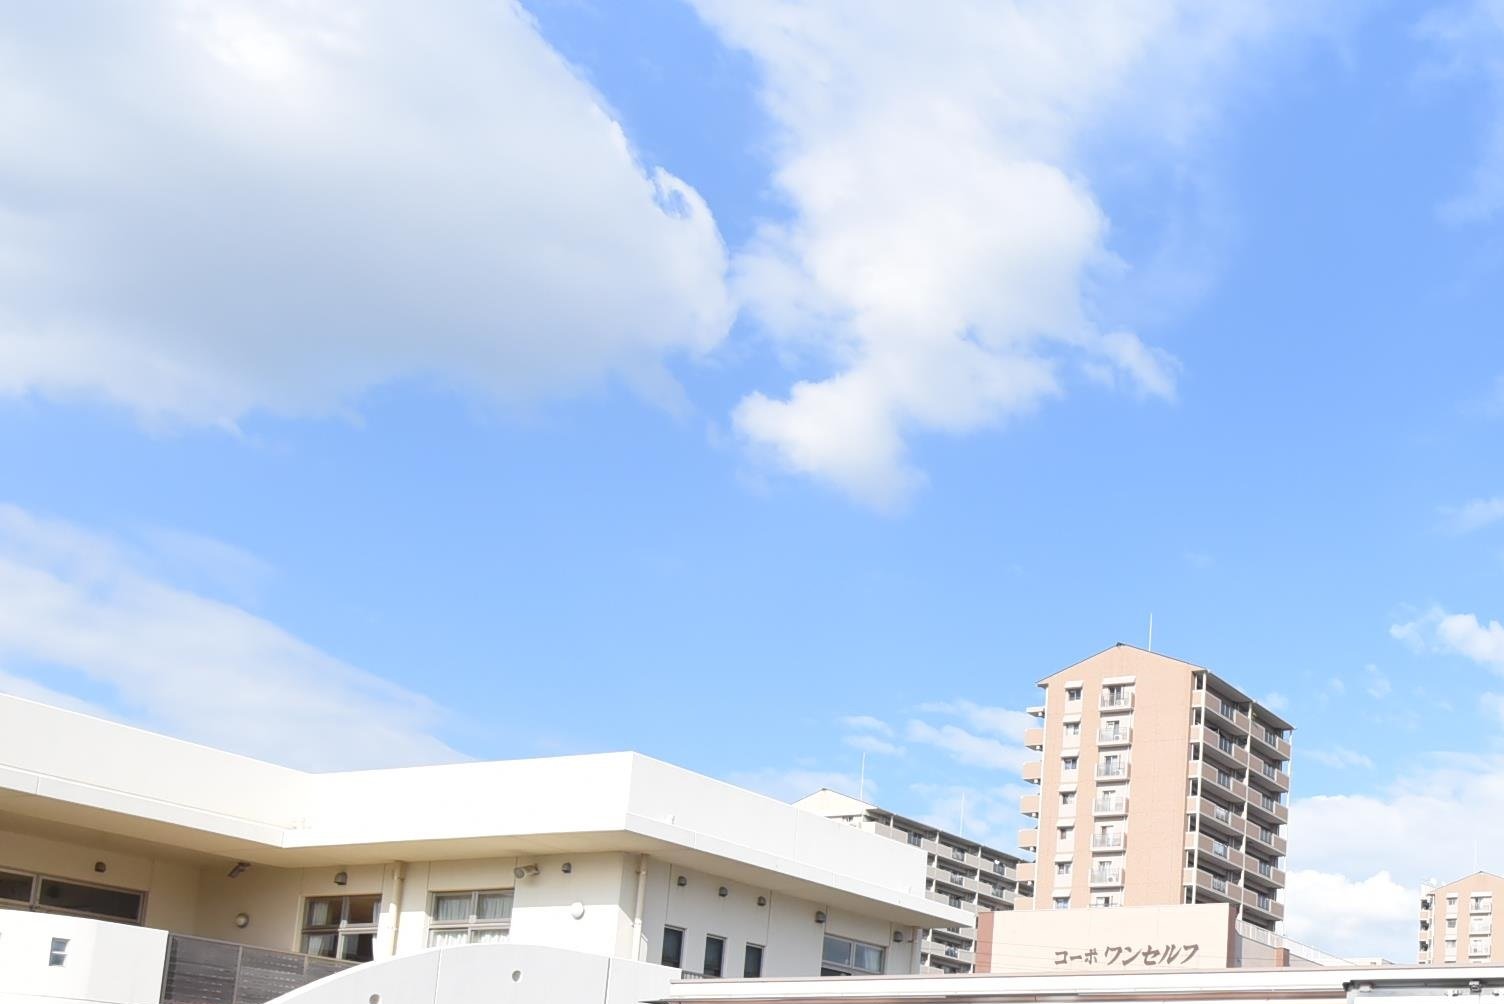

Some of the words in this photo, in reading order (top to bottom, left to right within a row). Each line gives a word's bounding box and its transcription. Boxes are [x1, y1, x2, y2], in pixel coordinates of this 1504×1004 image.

[1054, 949, 1098, 965] コーポ
[1104, 944, 1199, 966] ワンセルフ
